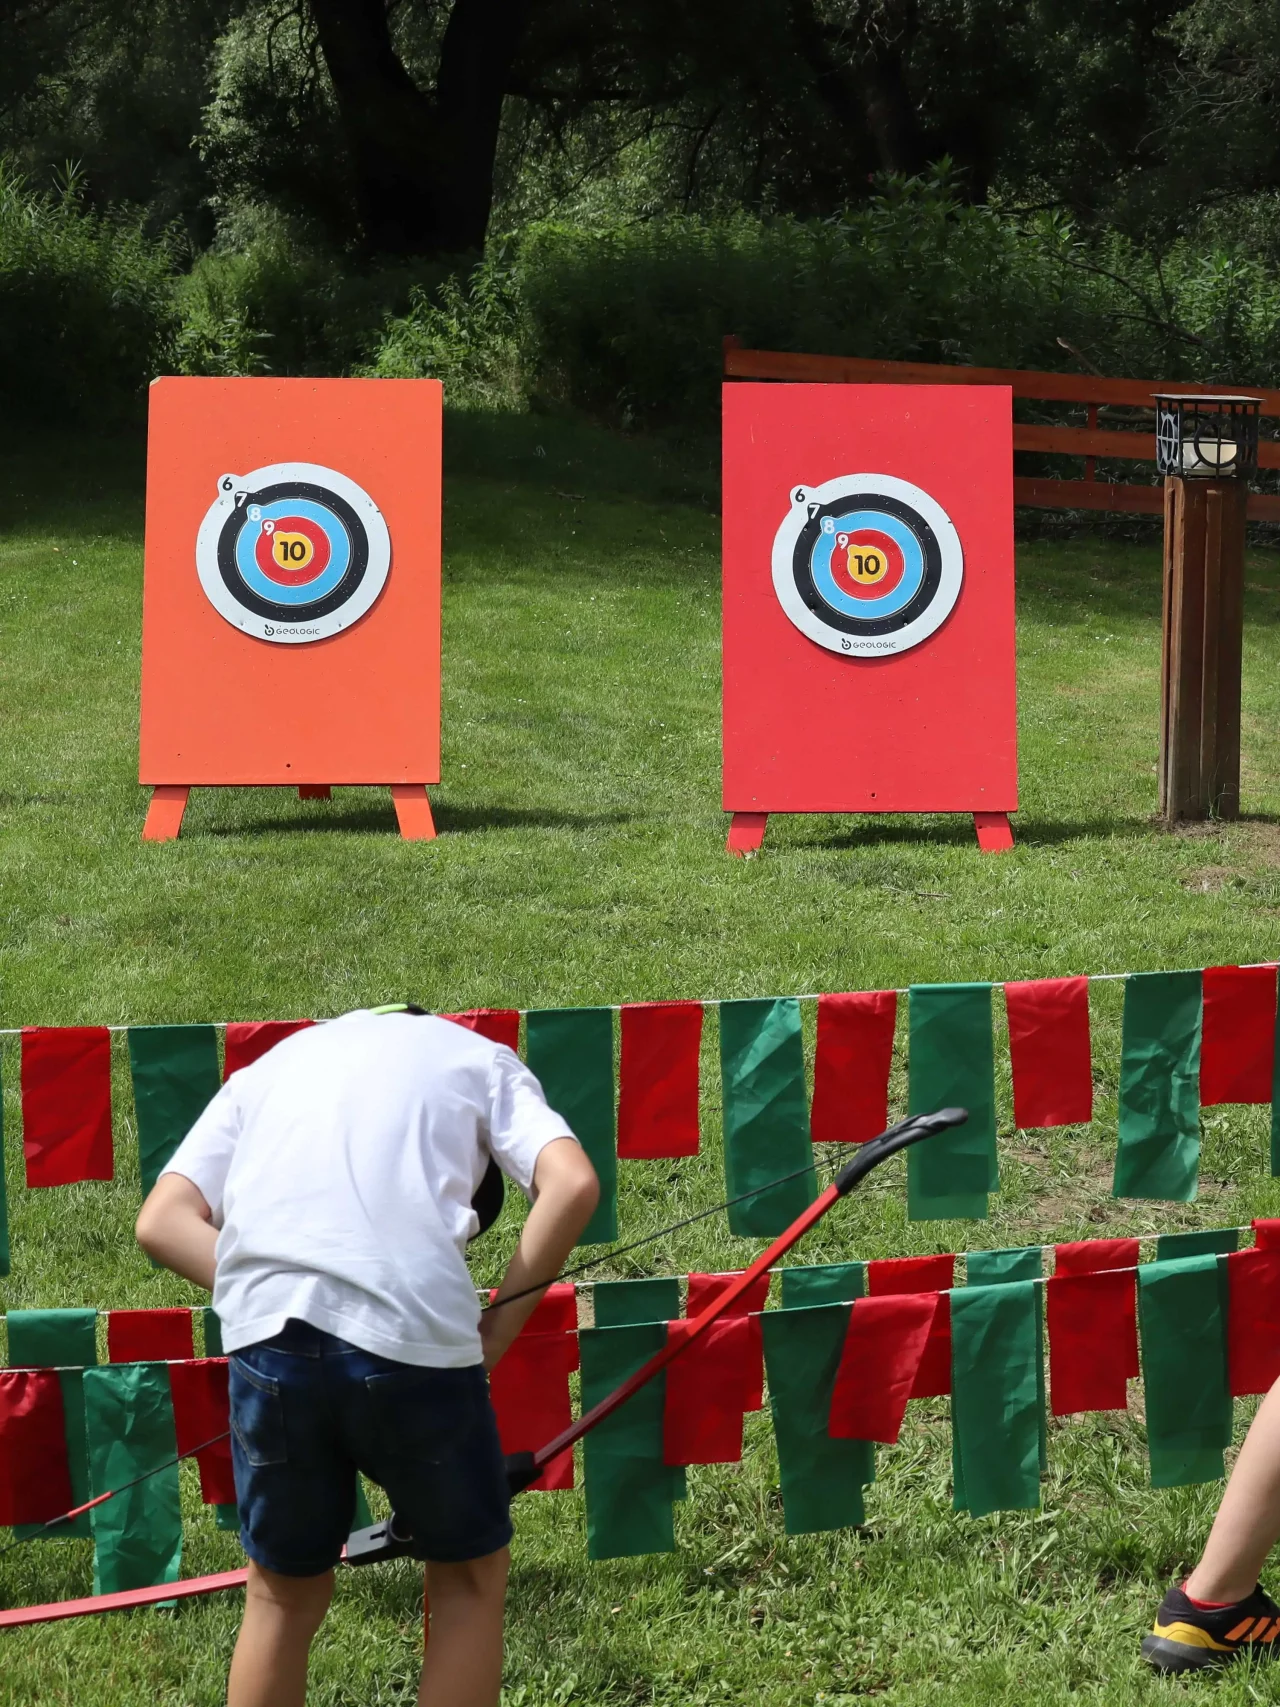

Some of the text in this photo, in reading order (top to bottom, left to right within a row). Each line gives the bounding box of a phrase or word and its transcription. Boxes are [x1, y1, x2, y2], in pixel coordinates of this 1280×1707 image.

[222, 477, 233, 491] 6
[236, 493, 248, 508] 7
[795, 488, 806, 503] 6
[250, 507, 262, 522] 8
[809, 505, 821, 520] 7
[264, 521, 275, 536] 9
[824, 519, 835, 534] 8
[837, 535, 849, 549] 9
[279, 541, 306, 561] 10
[854, 555, 880, 575] 10
